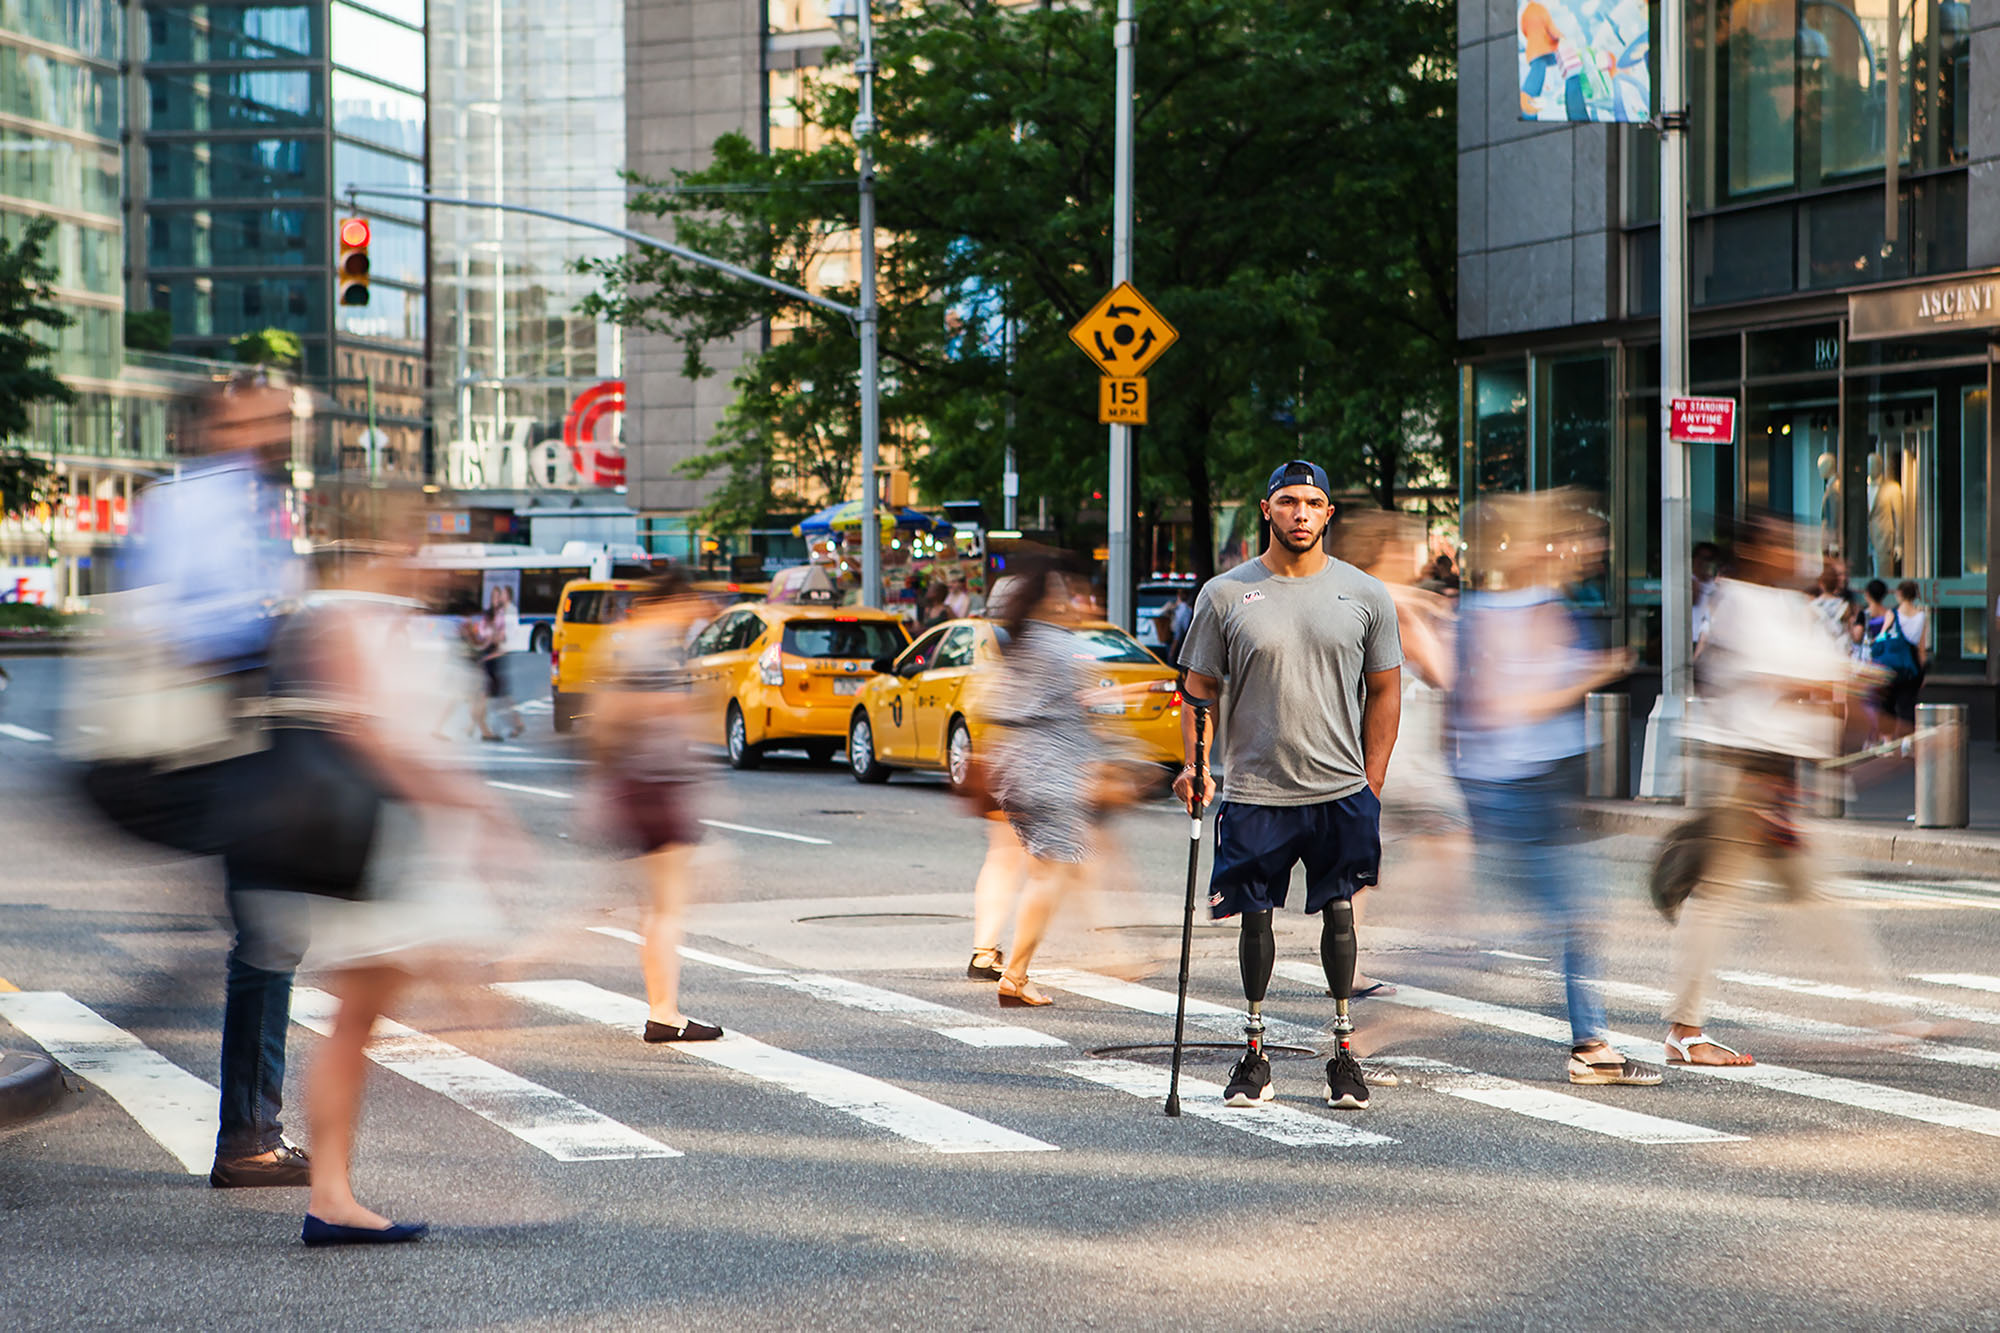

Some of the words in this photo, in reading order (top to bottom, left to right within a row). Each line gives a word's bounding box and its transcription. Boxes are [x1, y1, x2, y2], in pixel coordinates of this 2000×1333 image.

[1918, 284, 1996, 317] ASCENT
[1110, 382, 1138, 404] 15
[1675, 401, 1687, 411] NO
[1690, 401, 1730, 413] STANDING
[1681, 413, 1723, 425] ANYTIME
